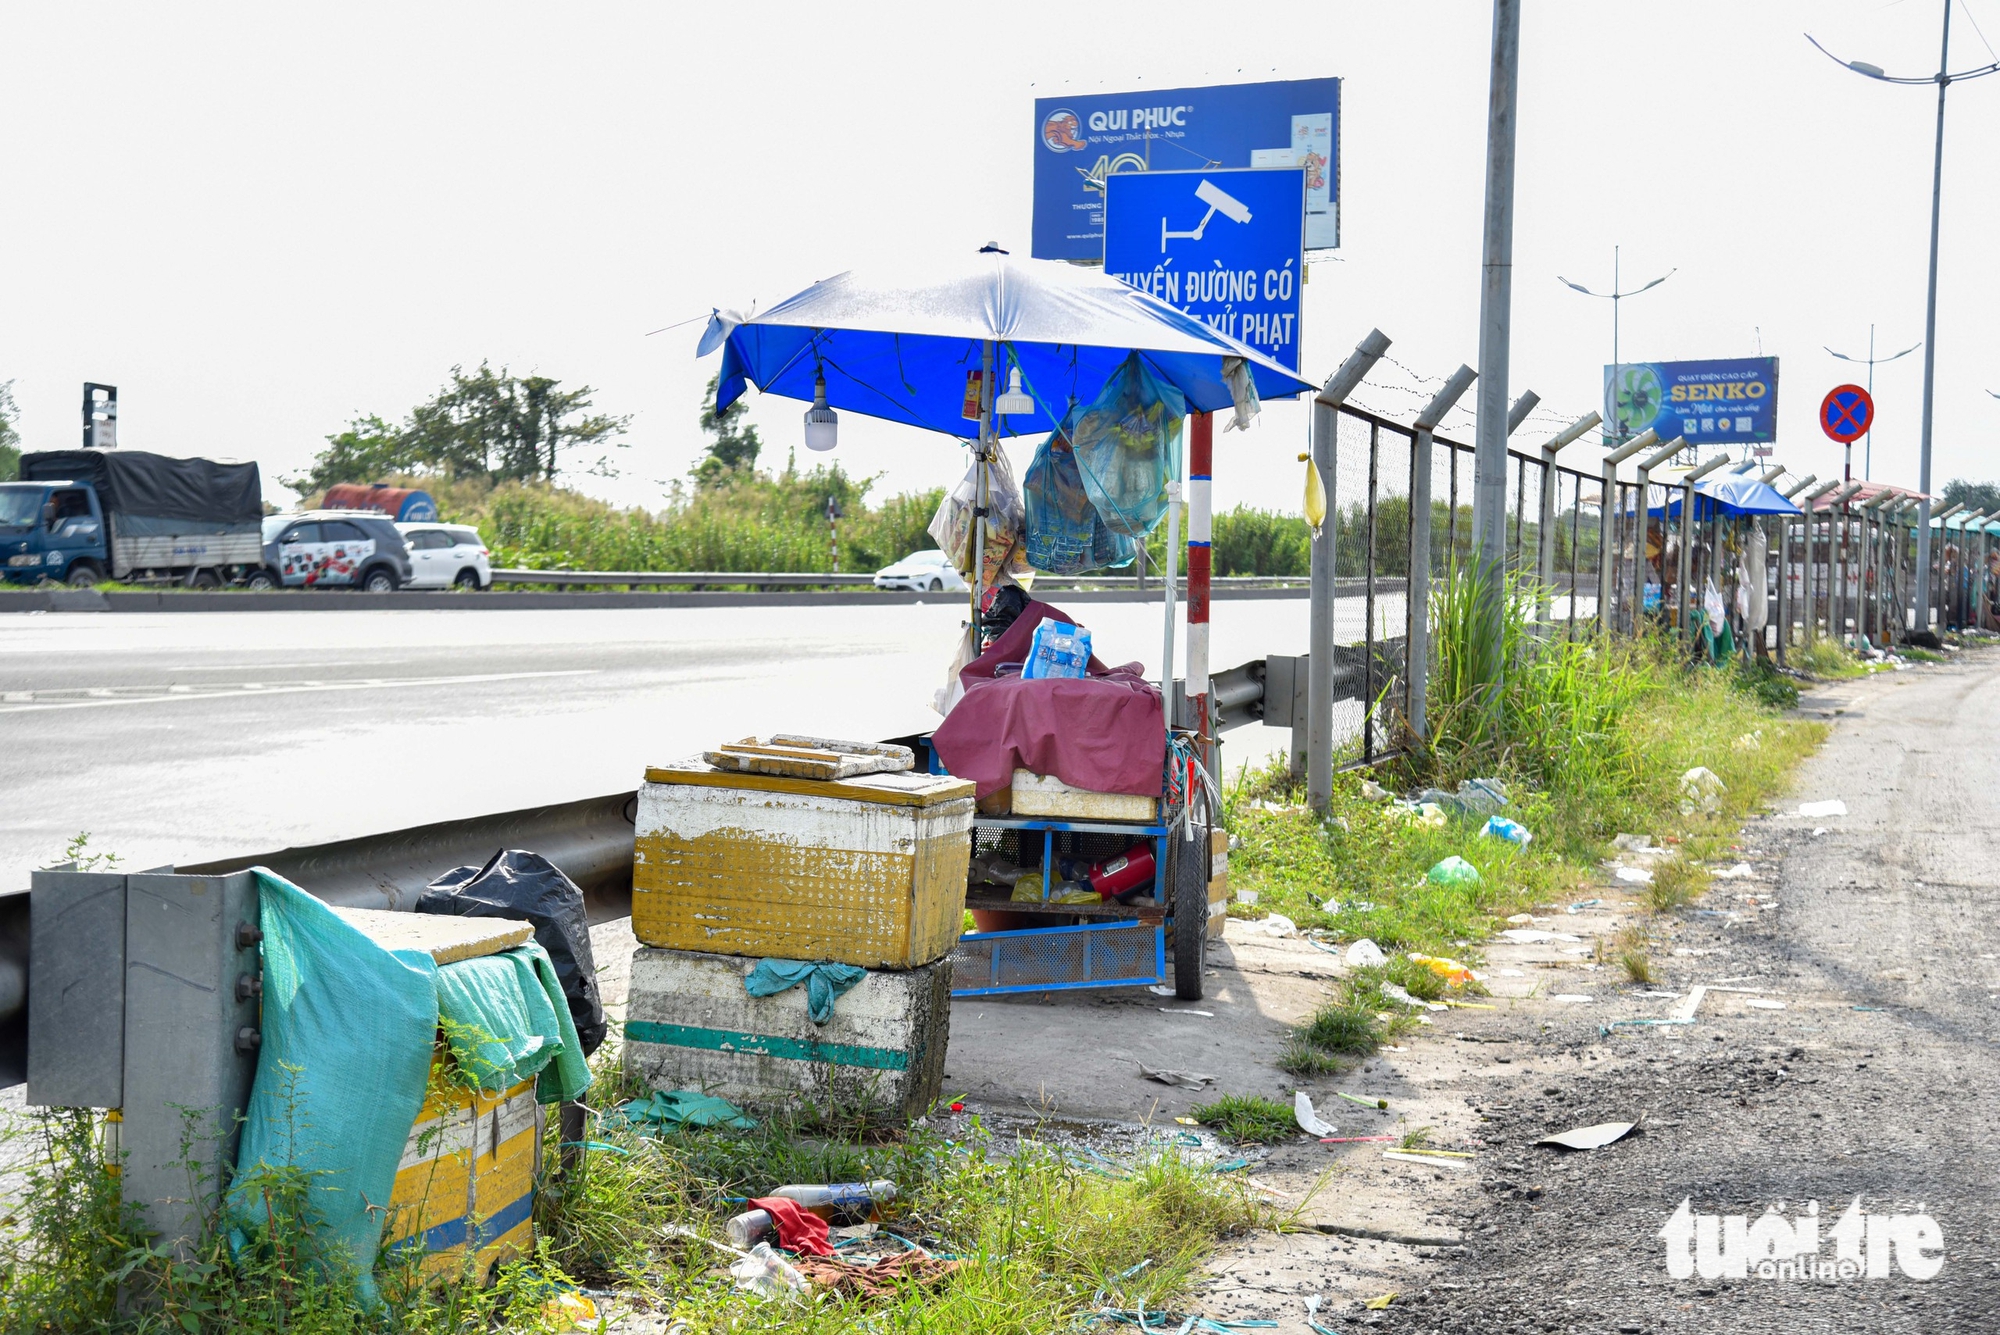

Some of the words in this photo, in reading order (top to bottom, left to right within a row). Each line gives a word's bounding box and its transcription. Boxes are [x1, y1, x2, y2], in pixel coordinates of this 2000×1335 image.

[1089, 109, 1128, 131] QUI
[1113, 258, 1179, 303] YẾN
[1185, 260, 1257, 303] ĐƯỜNG
[1264, 258, 1293, 301] CÓ
[1241, 313, 1295, 352] PHẠT
[1721, 372, 1739, 380] CAO
[1671, 381, 1766, 402] SENKO
